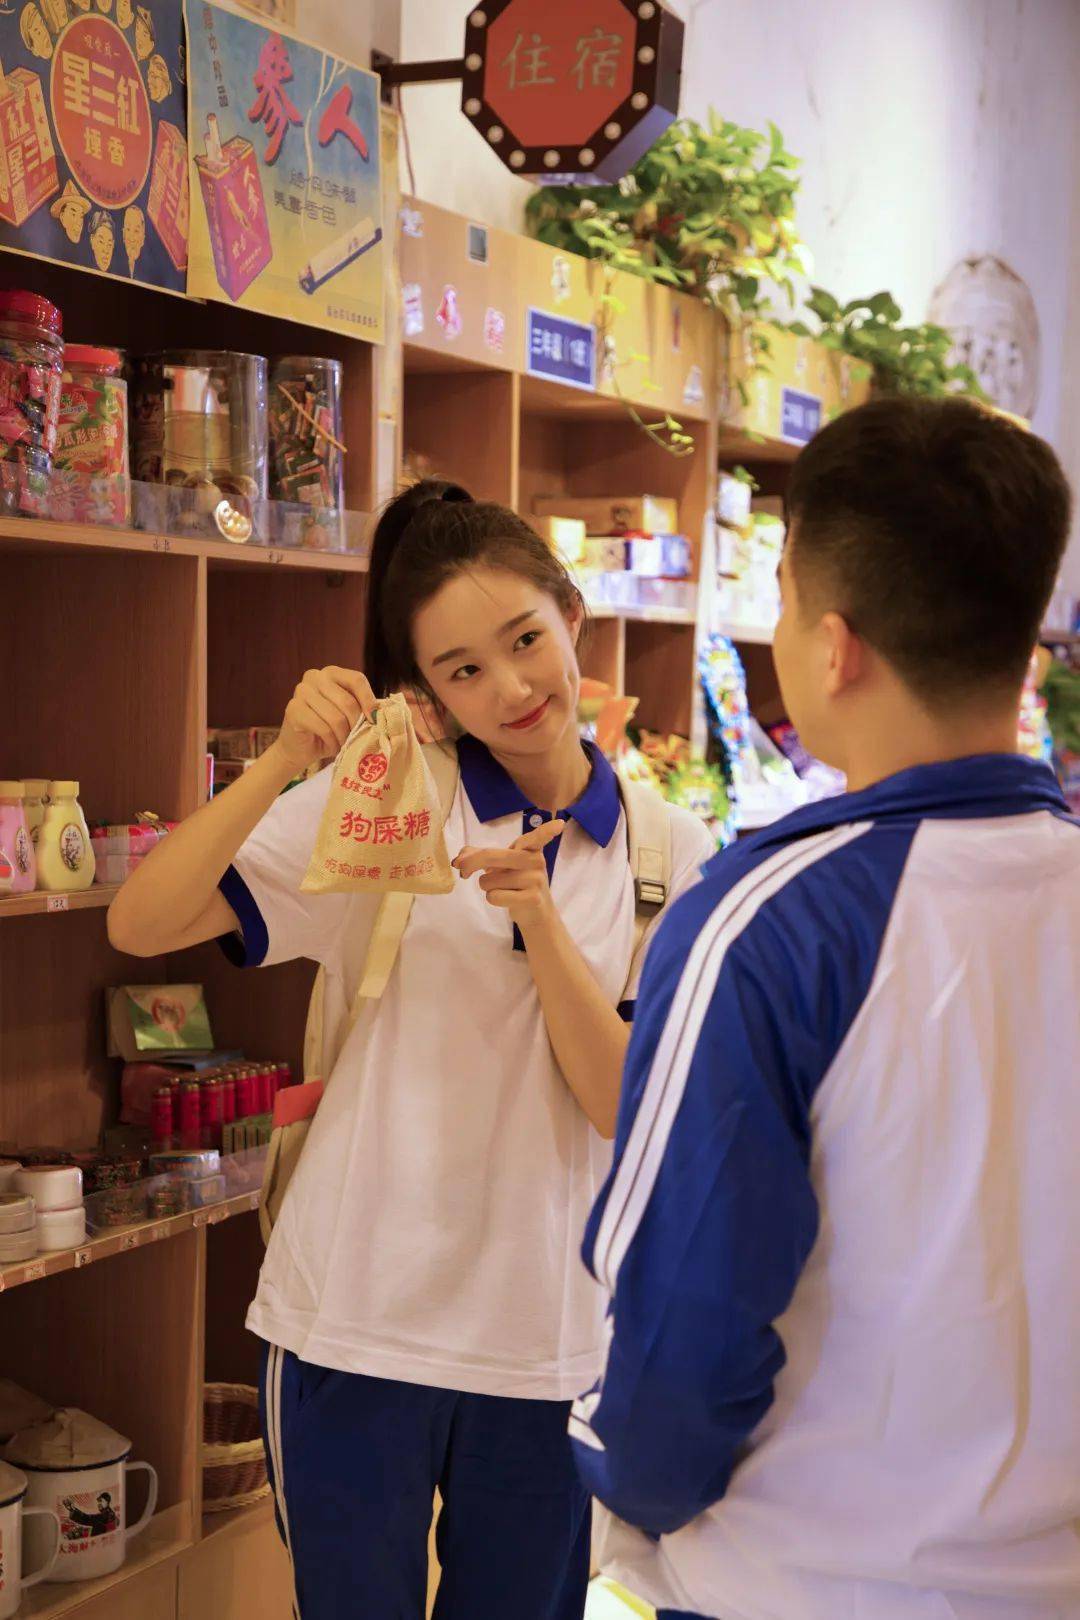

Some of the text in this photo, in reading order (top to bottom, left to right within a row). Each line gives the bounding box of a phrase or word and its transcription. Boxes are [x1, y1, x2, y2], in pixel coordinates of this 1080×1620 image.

[501, 28, 624, 90] 住宿
[340, 808, 431, 844] 狗屎糖
